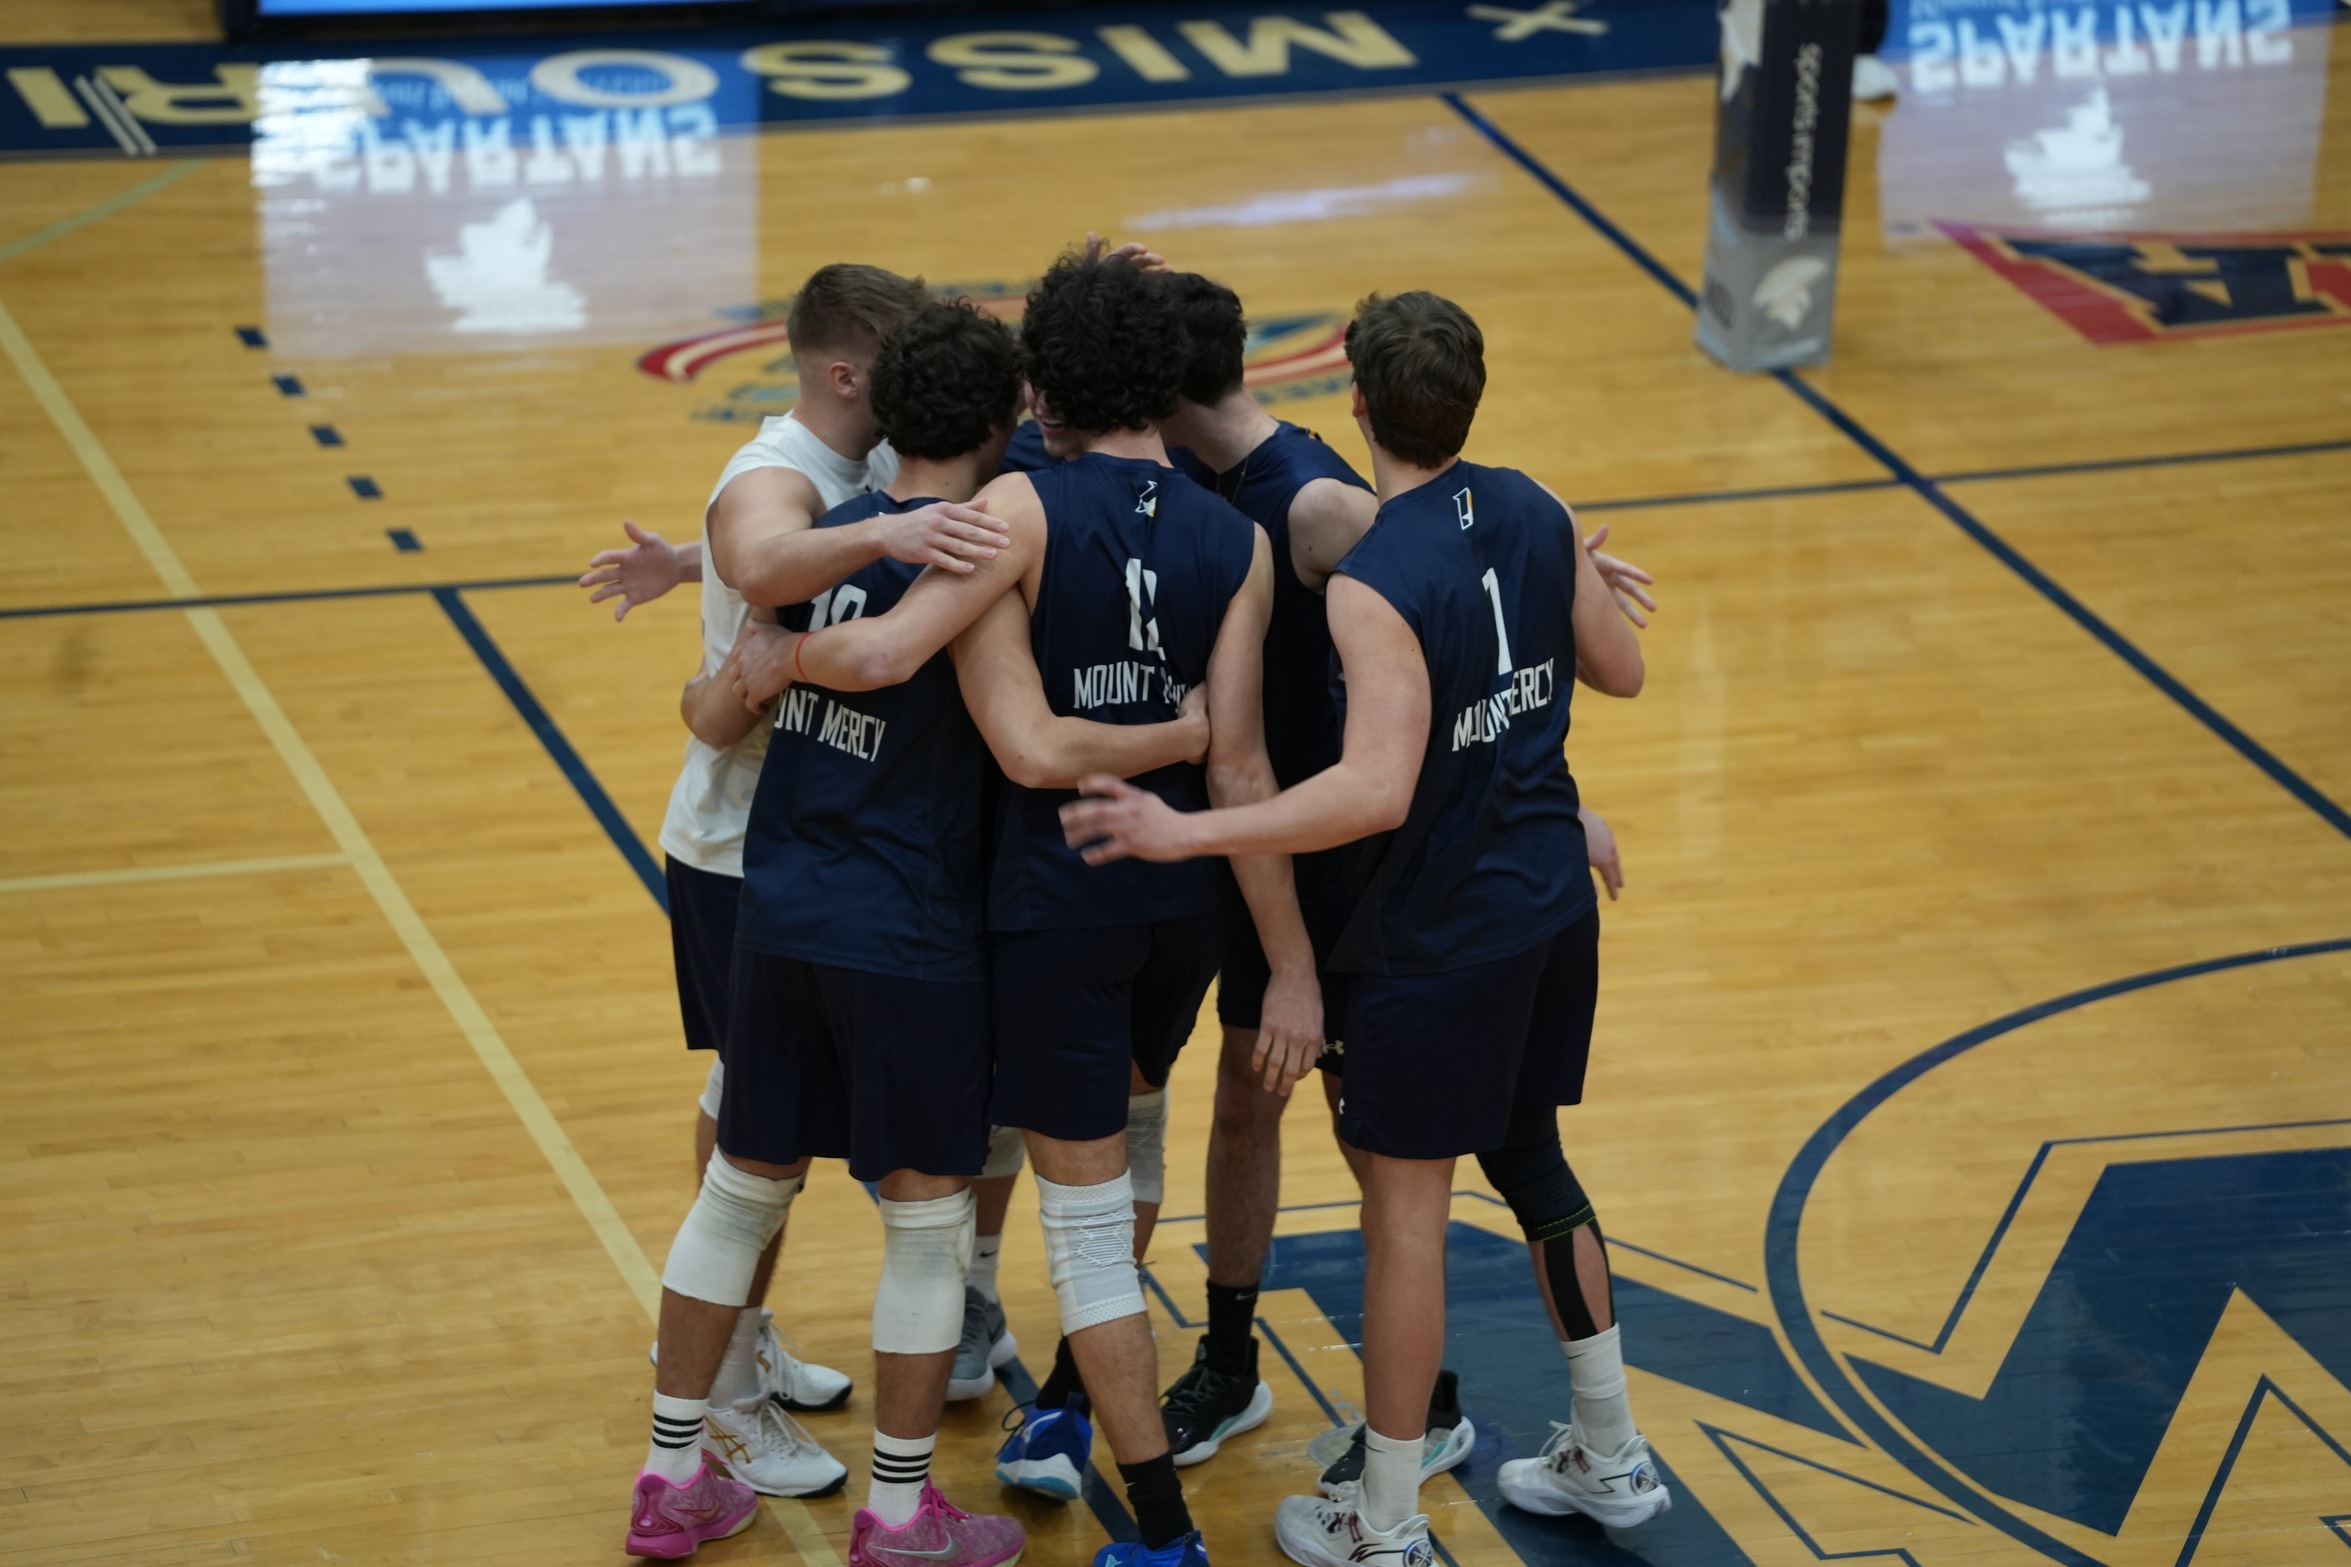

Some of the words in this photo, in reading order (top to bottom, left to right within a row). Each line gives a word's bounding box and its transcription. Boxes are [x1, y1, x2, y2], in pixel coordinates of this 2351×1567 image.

[1792, 43, 1823, 130] sports
[1785, 133, 1814, 241] imports
[1482, 567, 1513, 676] 1
[1073, 660, 1155, 709] MOUNT
[1508, 657, 1554, 717] ERCY
[817, 699, 886, 762] MERCY
